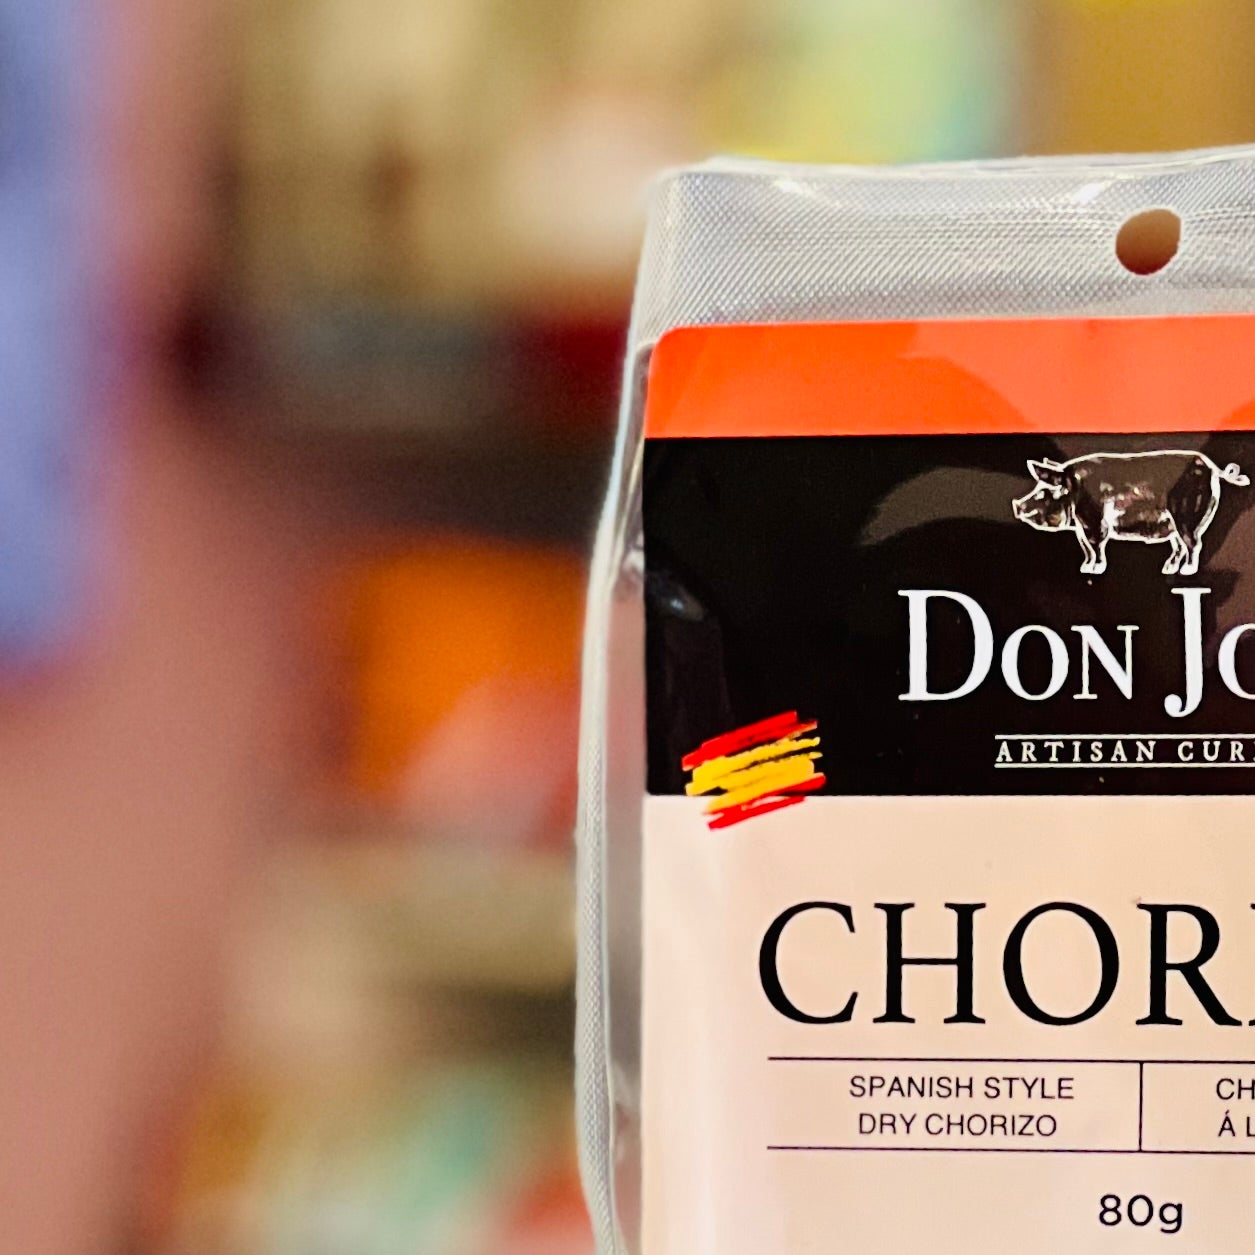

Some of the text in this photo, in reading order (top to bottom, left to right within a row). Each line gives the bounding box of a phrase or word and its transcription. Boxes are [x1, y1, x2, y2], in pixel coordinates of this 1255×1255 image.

[897, 588, 1140, 702] DON
[995, 740, 1157, 764] ARTISAN
[849, 1075, 1074, 1100] SPANISH STYLE
[858, 1112, 1057, 1137] DRY CHORIZO
[1217, 1109, 1236, 1138] Á
[1098, 1193, 1183, 1234] 80g
